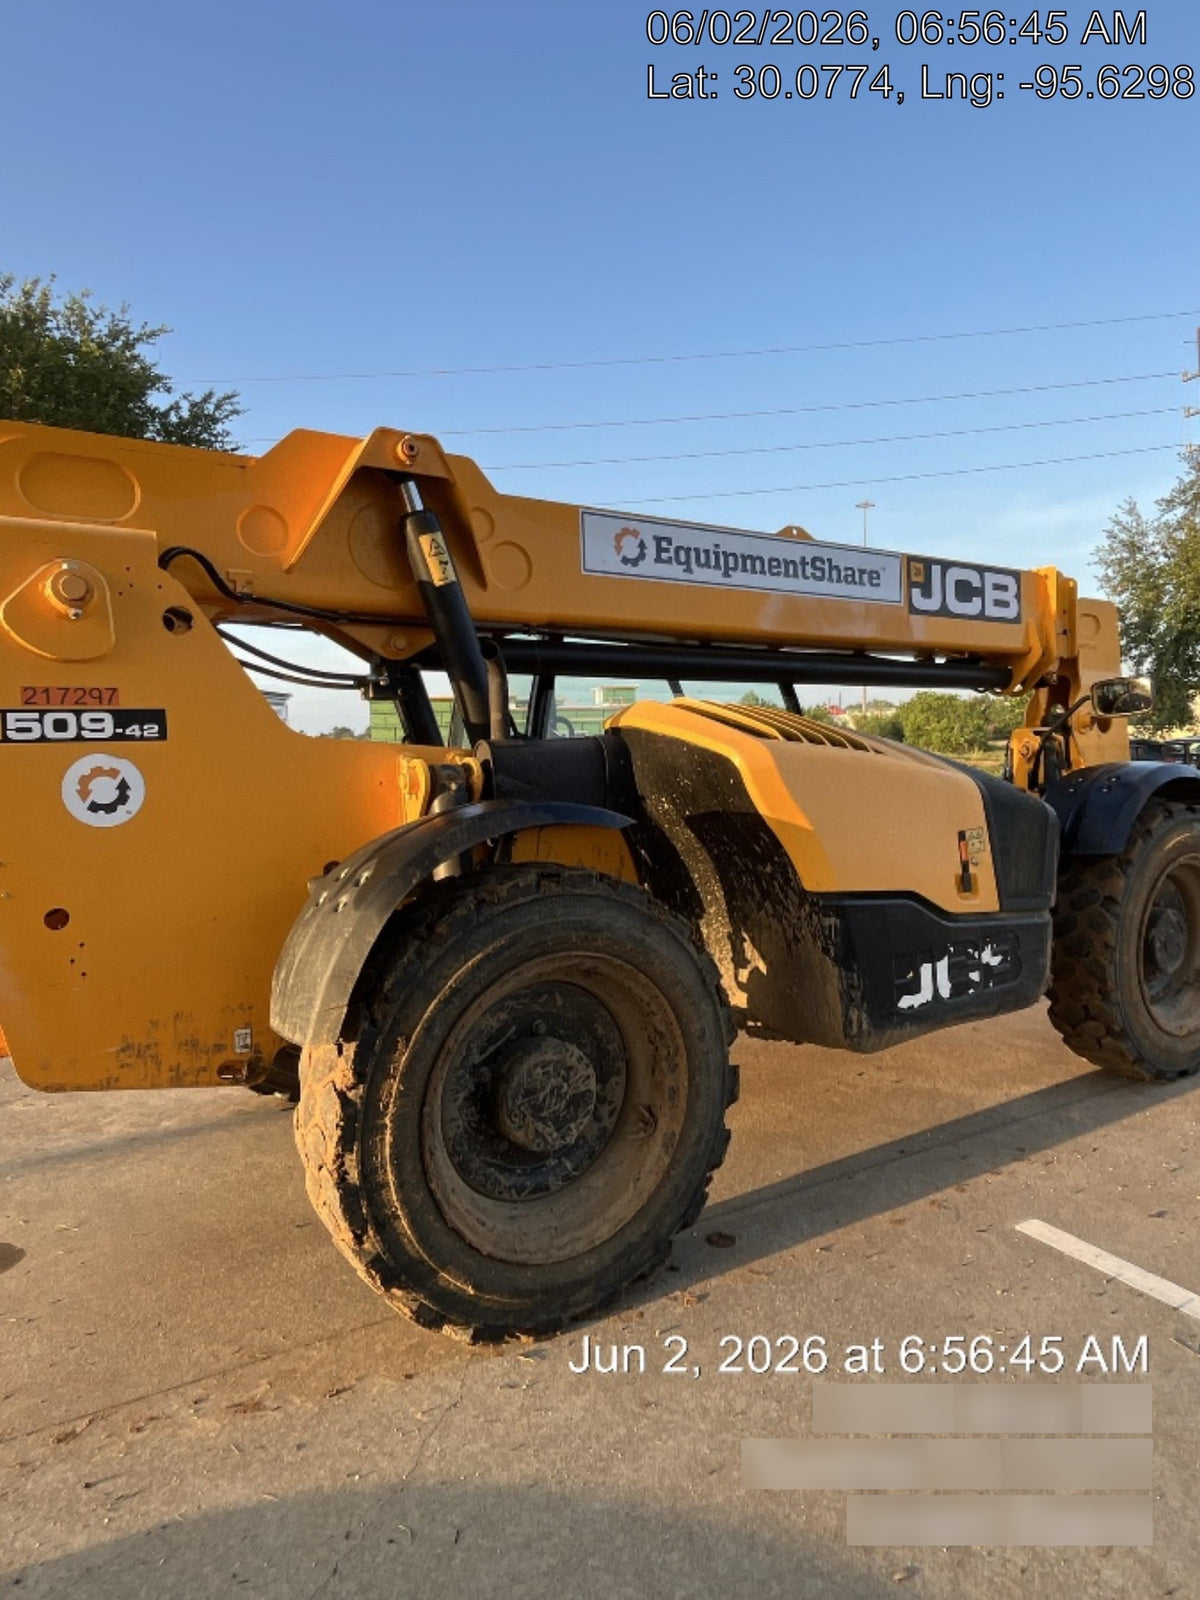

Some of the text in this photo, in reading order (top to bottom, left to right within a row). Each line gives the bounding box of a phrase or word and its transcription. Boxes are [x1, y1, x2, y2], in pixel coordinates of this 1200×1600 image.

[652, 535, 881, 587] EquipmentShare
[910, 564, 1020, 620] JCB
[23, 686, 118, 705] 217297
[6, 712, 159, 740] 509-42
